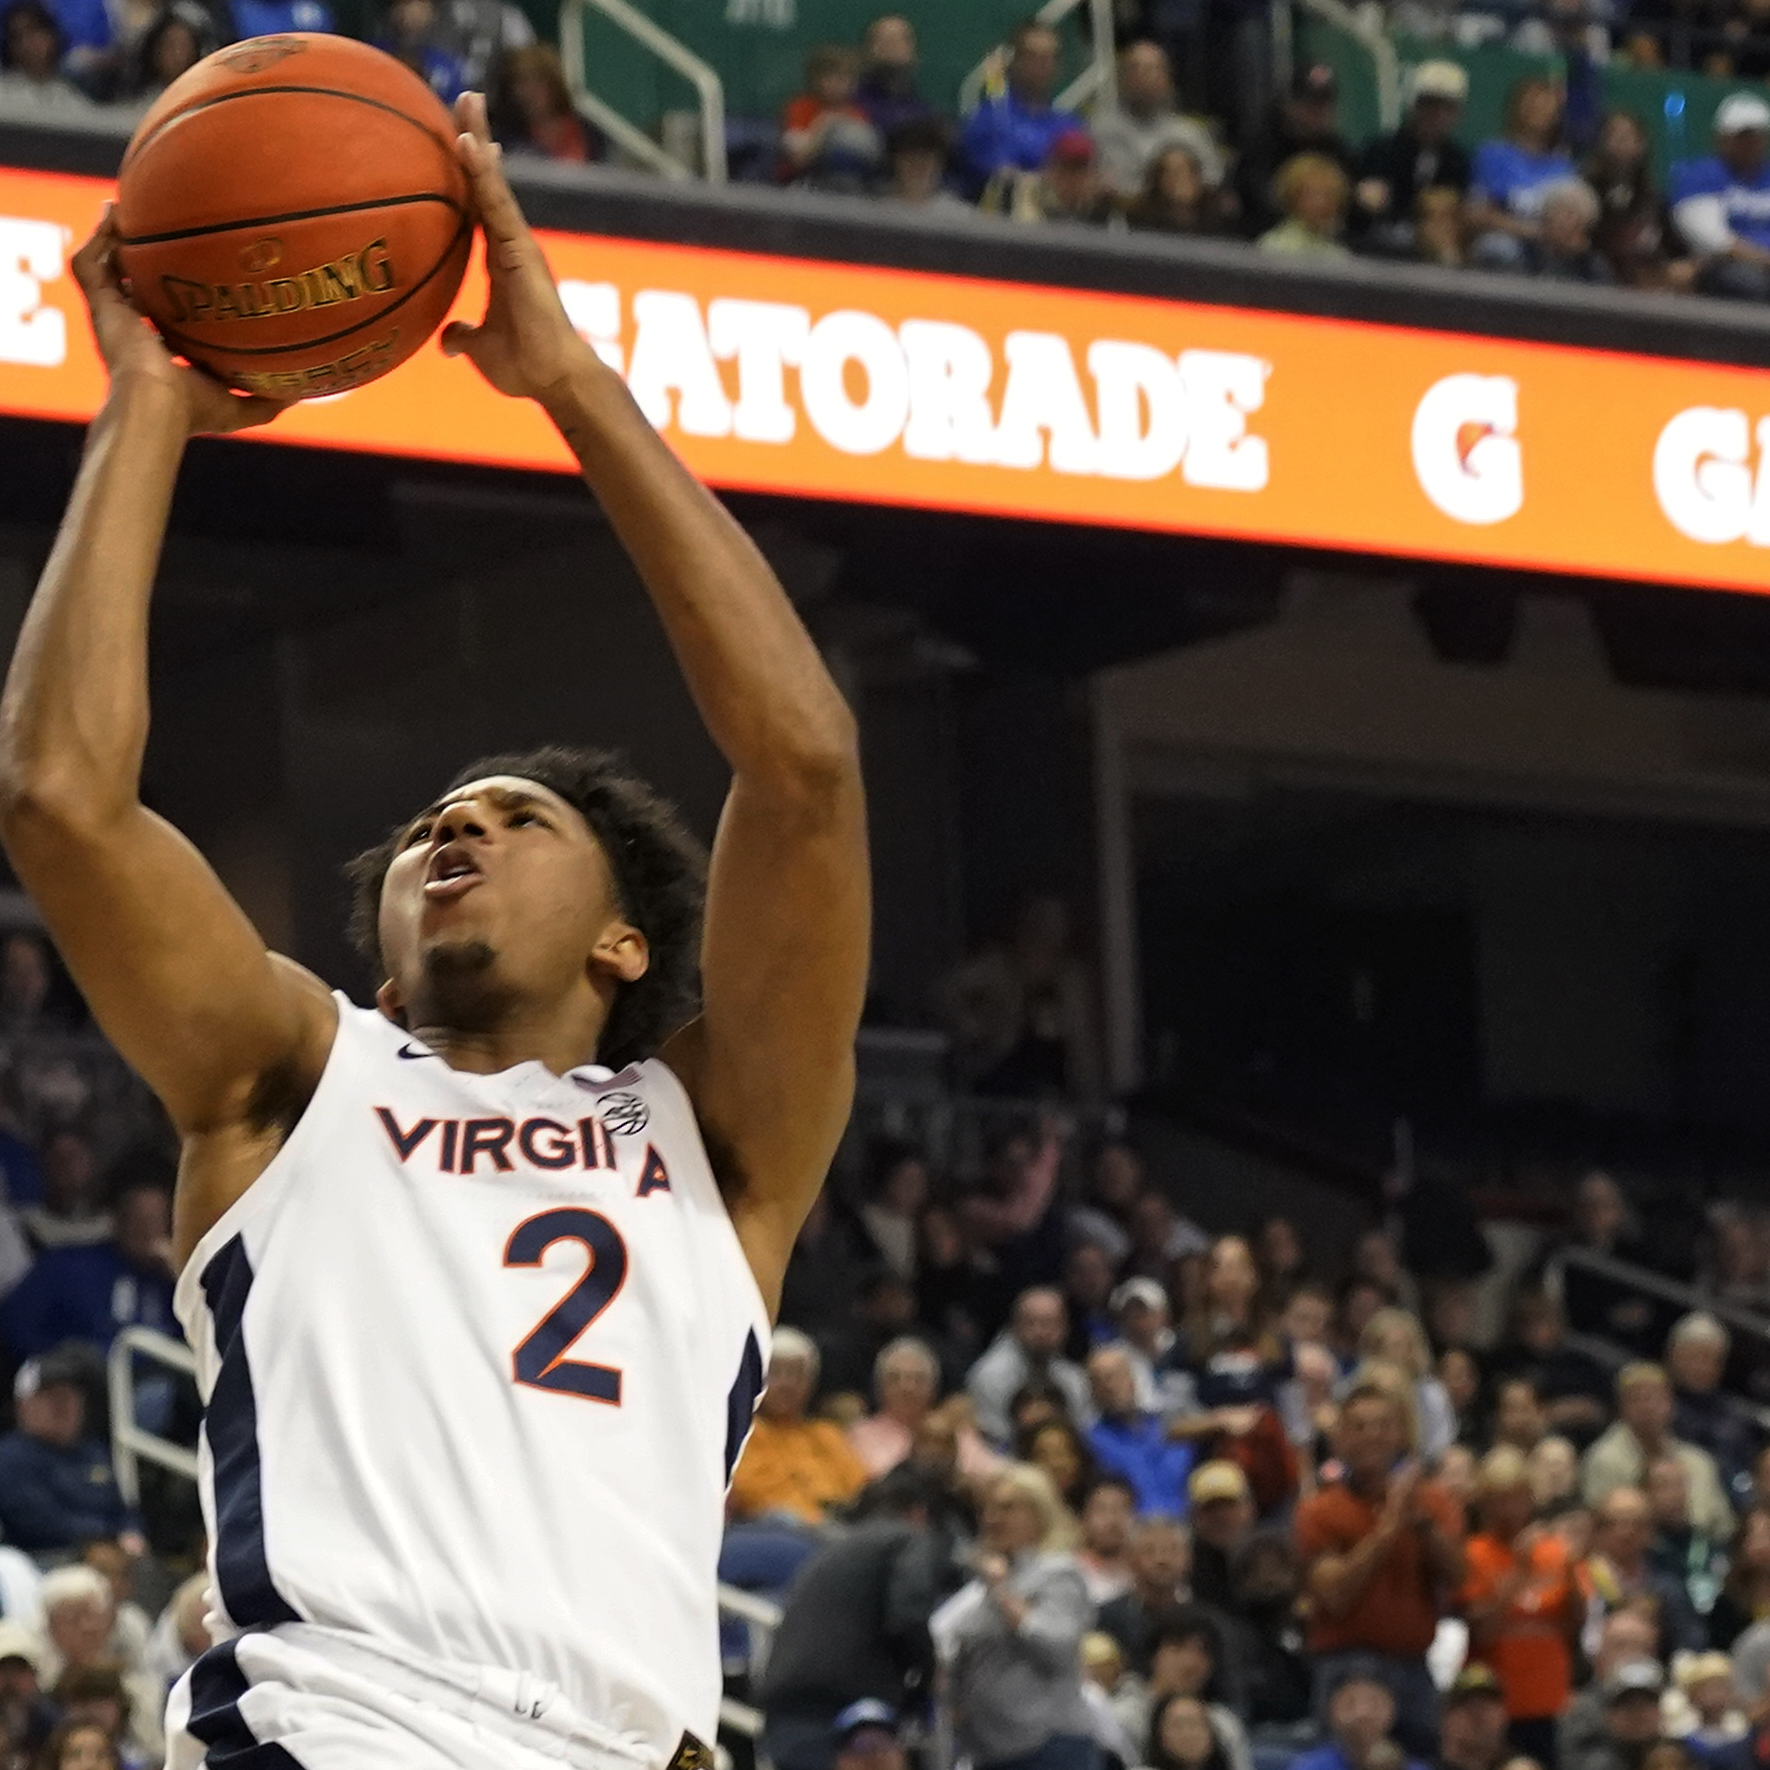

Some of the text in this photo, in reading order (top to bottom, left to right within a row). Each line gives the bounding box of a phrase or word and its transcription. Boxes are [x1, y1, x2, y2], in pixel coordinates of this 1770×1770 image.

[160, 237, 397, 323] SPALDING
[1410, 373, 1524, 525] G
[372, 1105, 672, 1198] VIRGIA
[503, 1206, 628, 1407] 2
